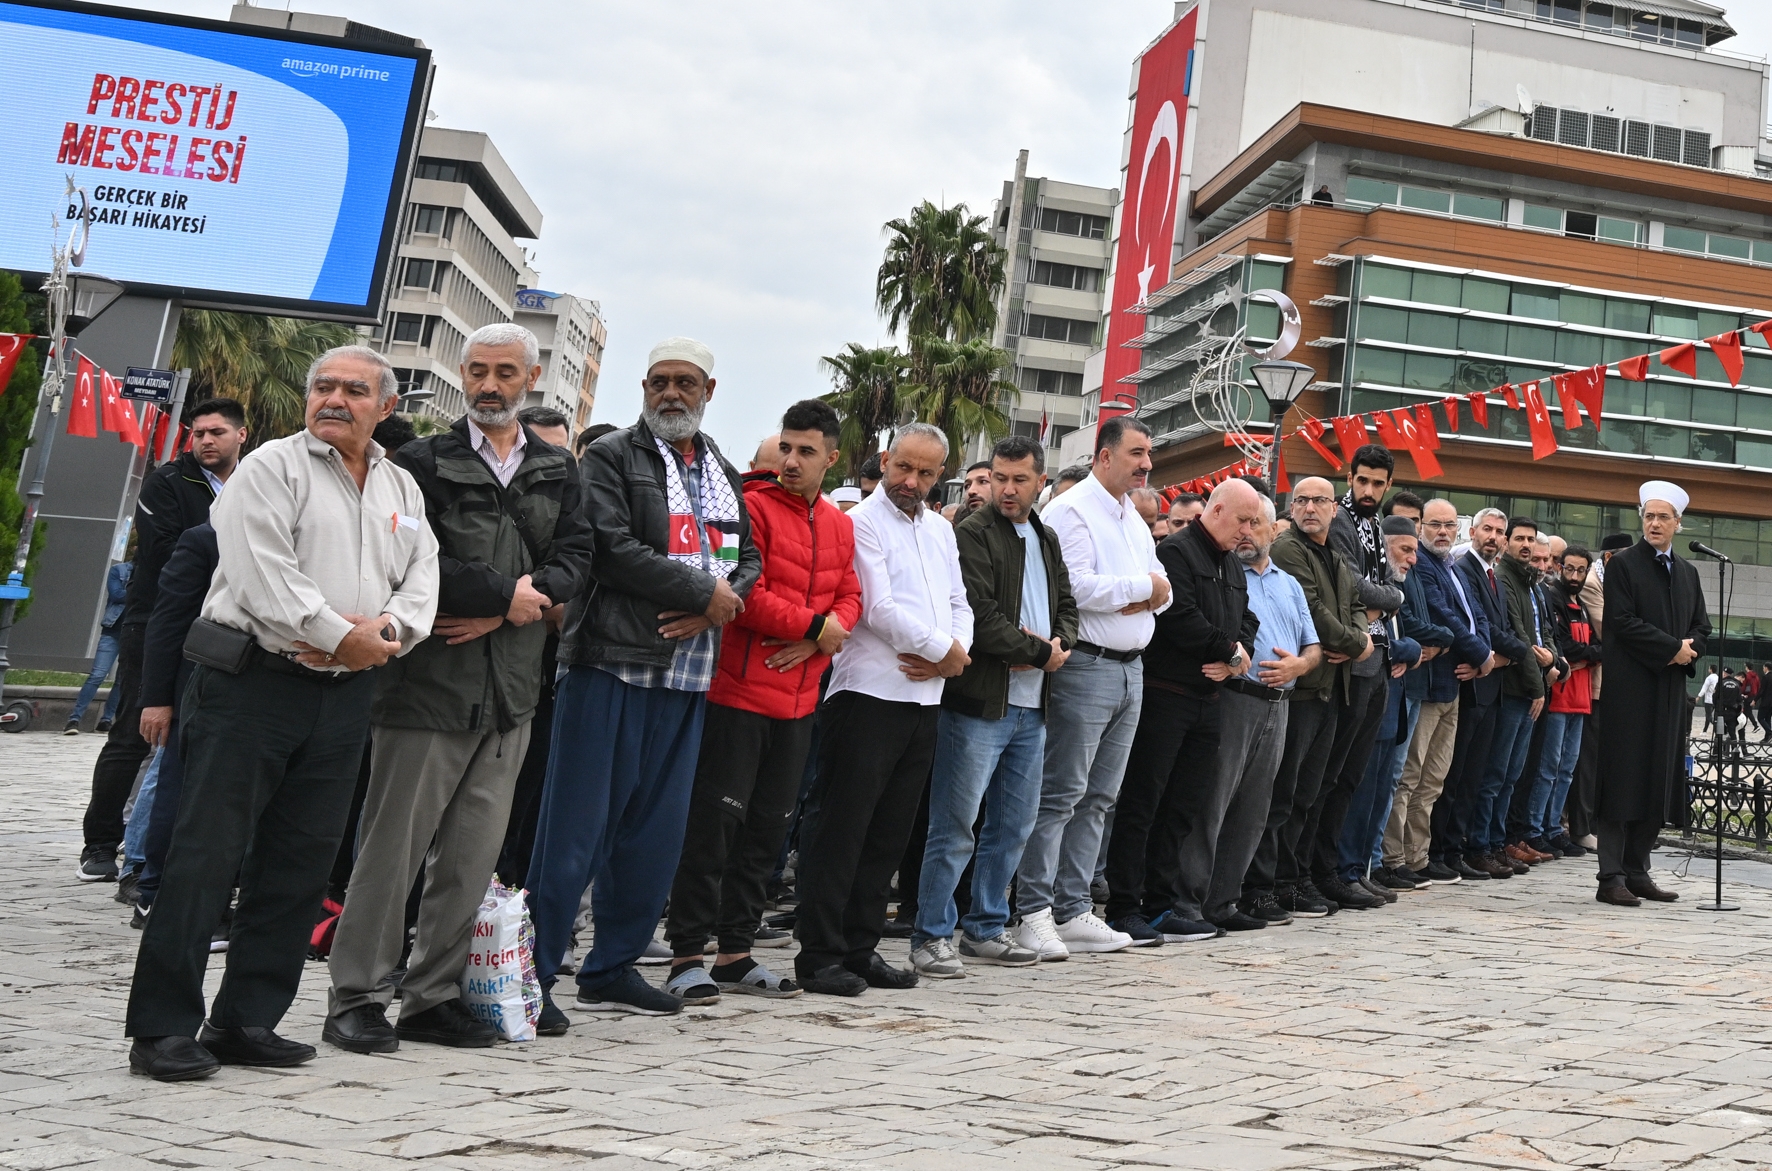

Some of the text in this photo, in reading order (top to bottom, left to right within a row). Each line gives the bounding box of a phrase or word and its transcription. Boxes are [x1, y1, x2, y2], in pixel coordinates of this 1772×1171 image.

[281, 58, 390, 82] amazon prime
[86, 73, 238, 131] PRESTİJ
[56, 121, 248, 184] MESELESİ
[94, 184, 189, 211] GERÇEK BİR
[66, 204, 207, 234] BAŞARI HİKAYESİ
[516, 294, 546, 308] SGK
[127, 376, 170, 389] KONAK ATATÜRK
[472, 921, 494, 937] ıklı
[486, 948, 514, 970] için
[469, 1003, 503, 1018] SIFIR
